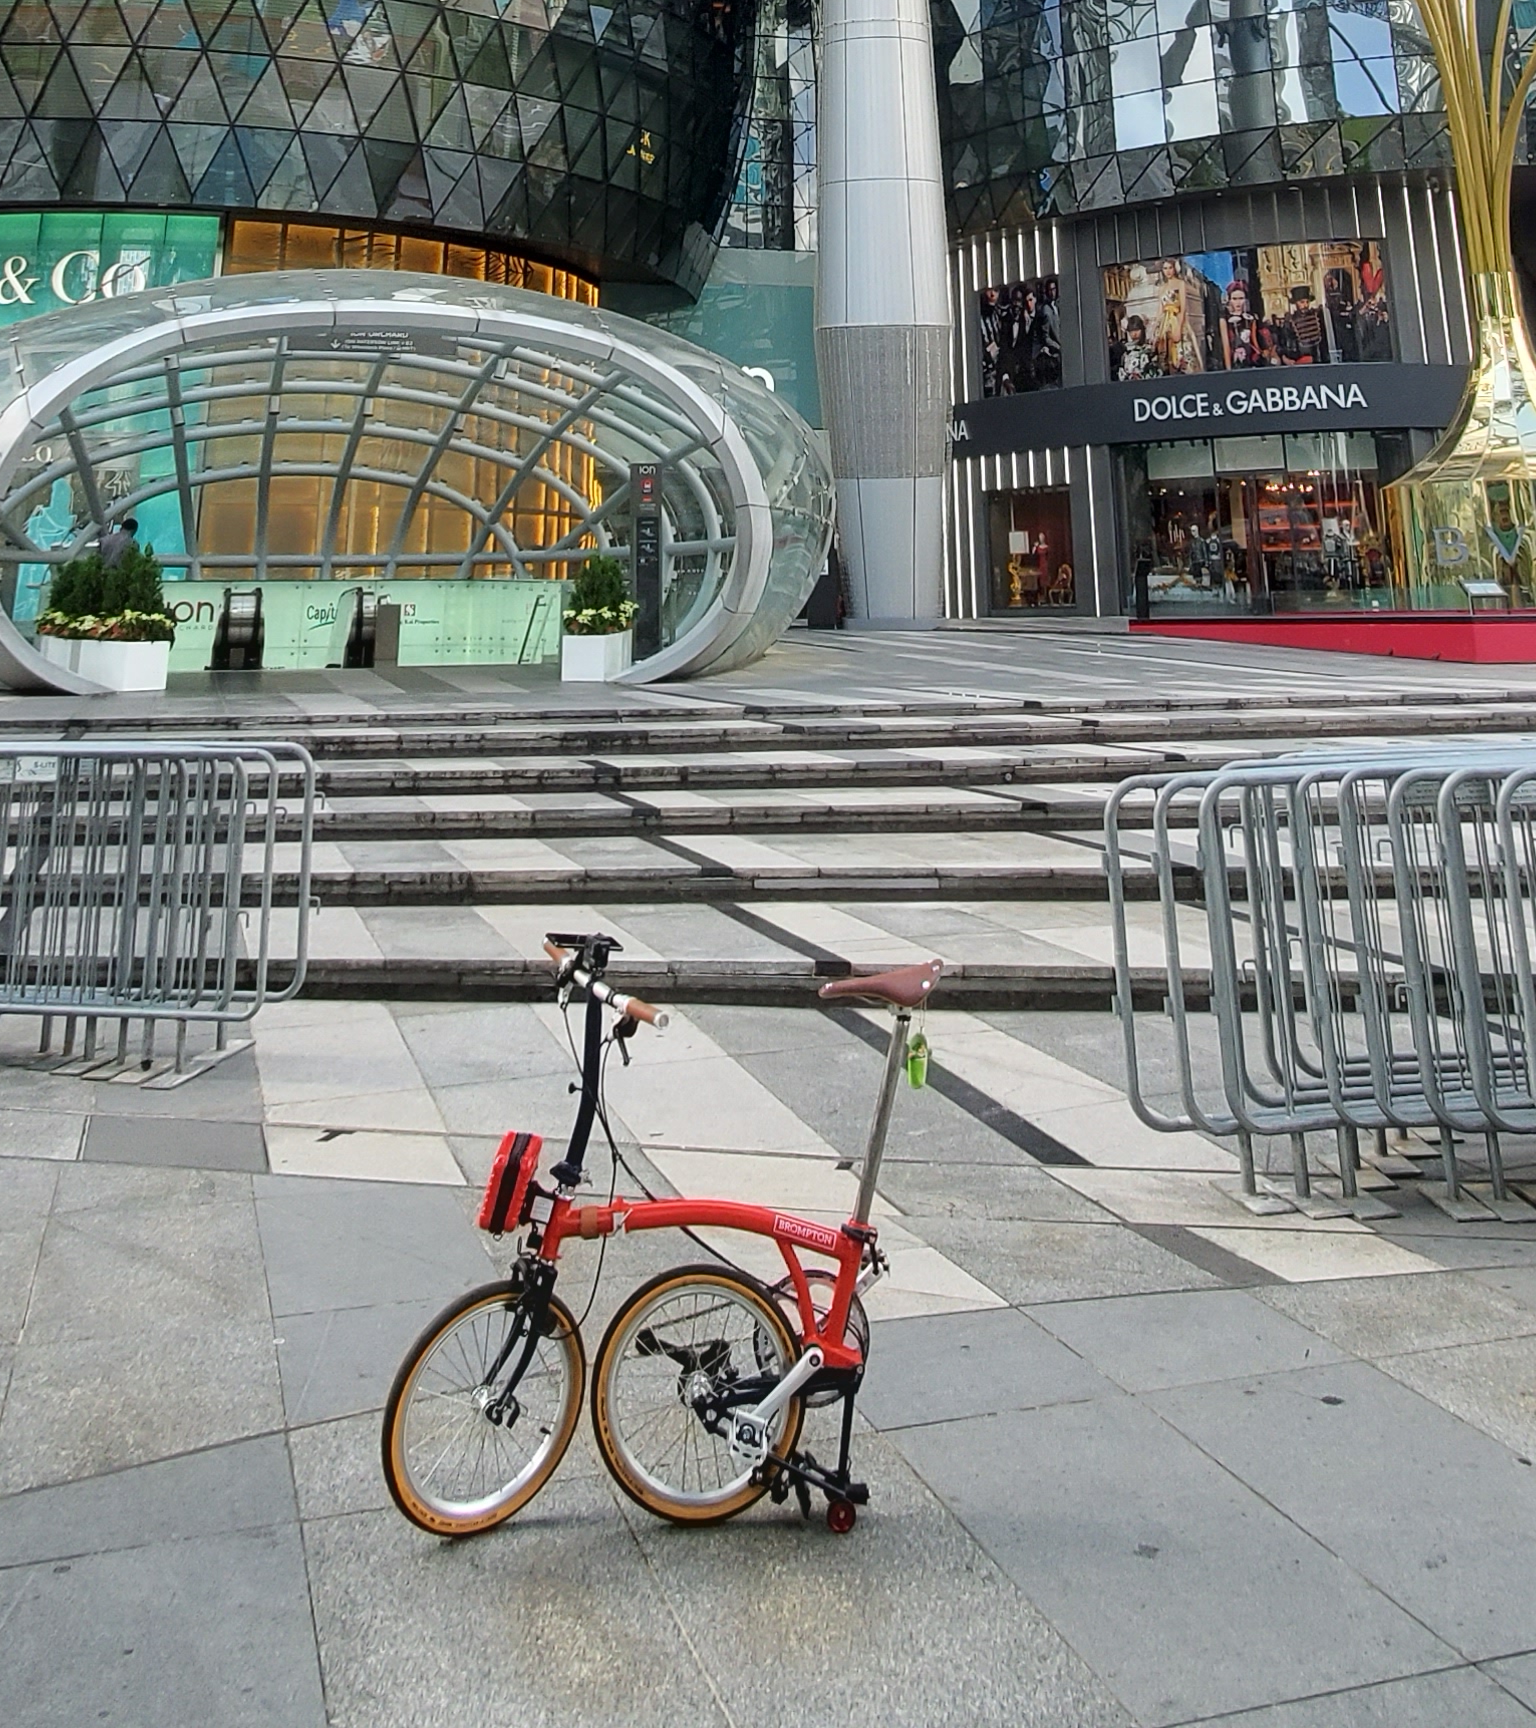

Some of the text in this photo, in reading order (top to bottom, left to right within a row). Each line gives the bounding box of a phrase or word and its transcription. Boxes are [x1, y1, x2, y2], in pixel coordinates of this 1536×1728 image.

[1133, 383, 1368, 422] DOLCE & GABBANA
[778, 1219, 833, 1245] BROMPTON
